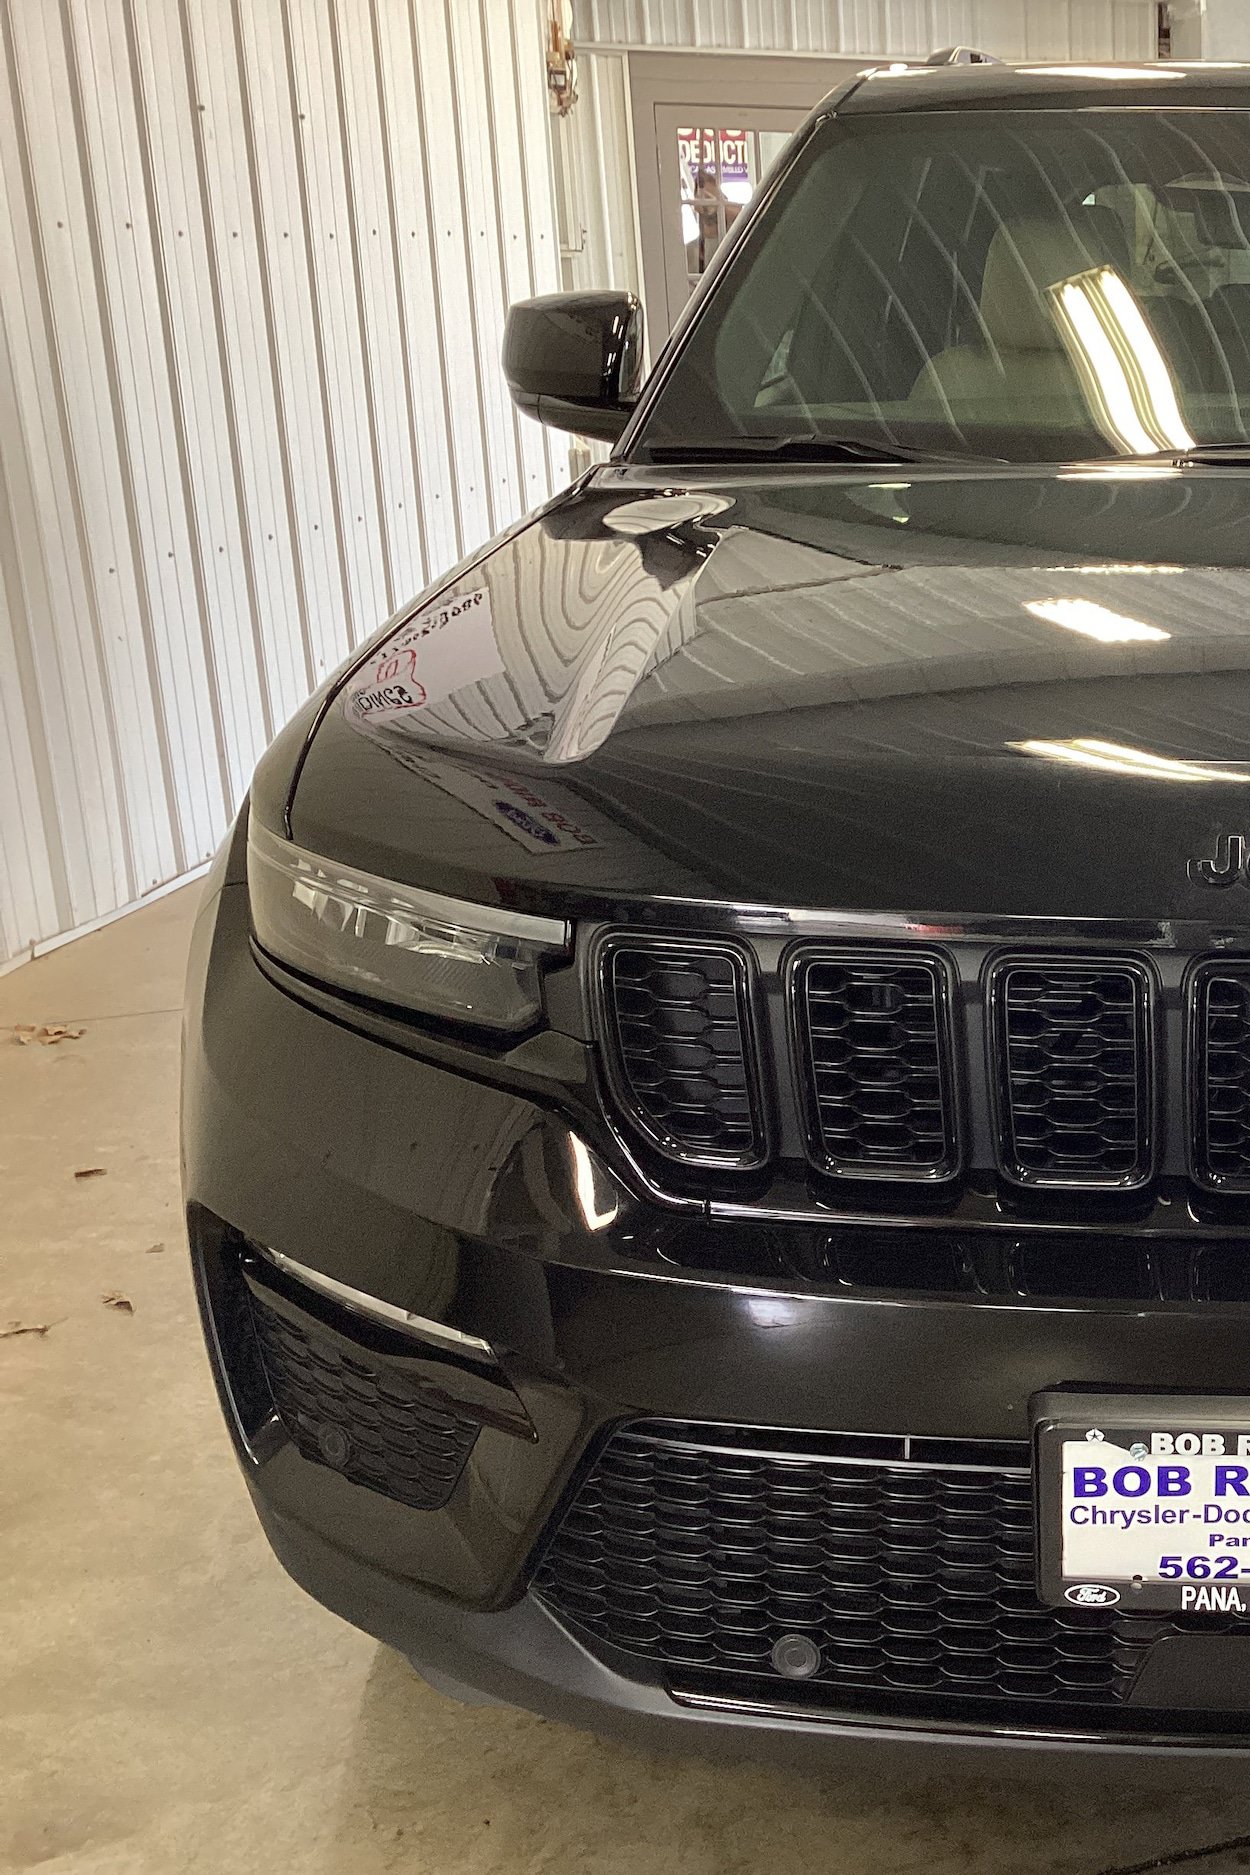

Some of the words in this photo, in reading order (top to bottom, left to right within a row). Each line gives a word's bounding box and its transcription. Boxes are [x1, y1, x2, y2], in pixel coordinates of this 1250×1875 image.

[1151, 1432, 1225, 1456] BOB
[1073, 1465, 1192, 1498] BOB
[1076, 1587, 1107, 1604] Ford
[1181, 1585, 1247, 1612] PANA,
